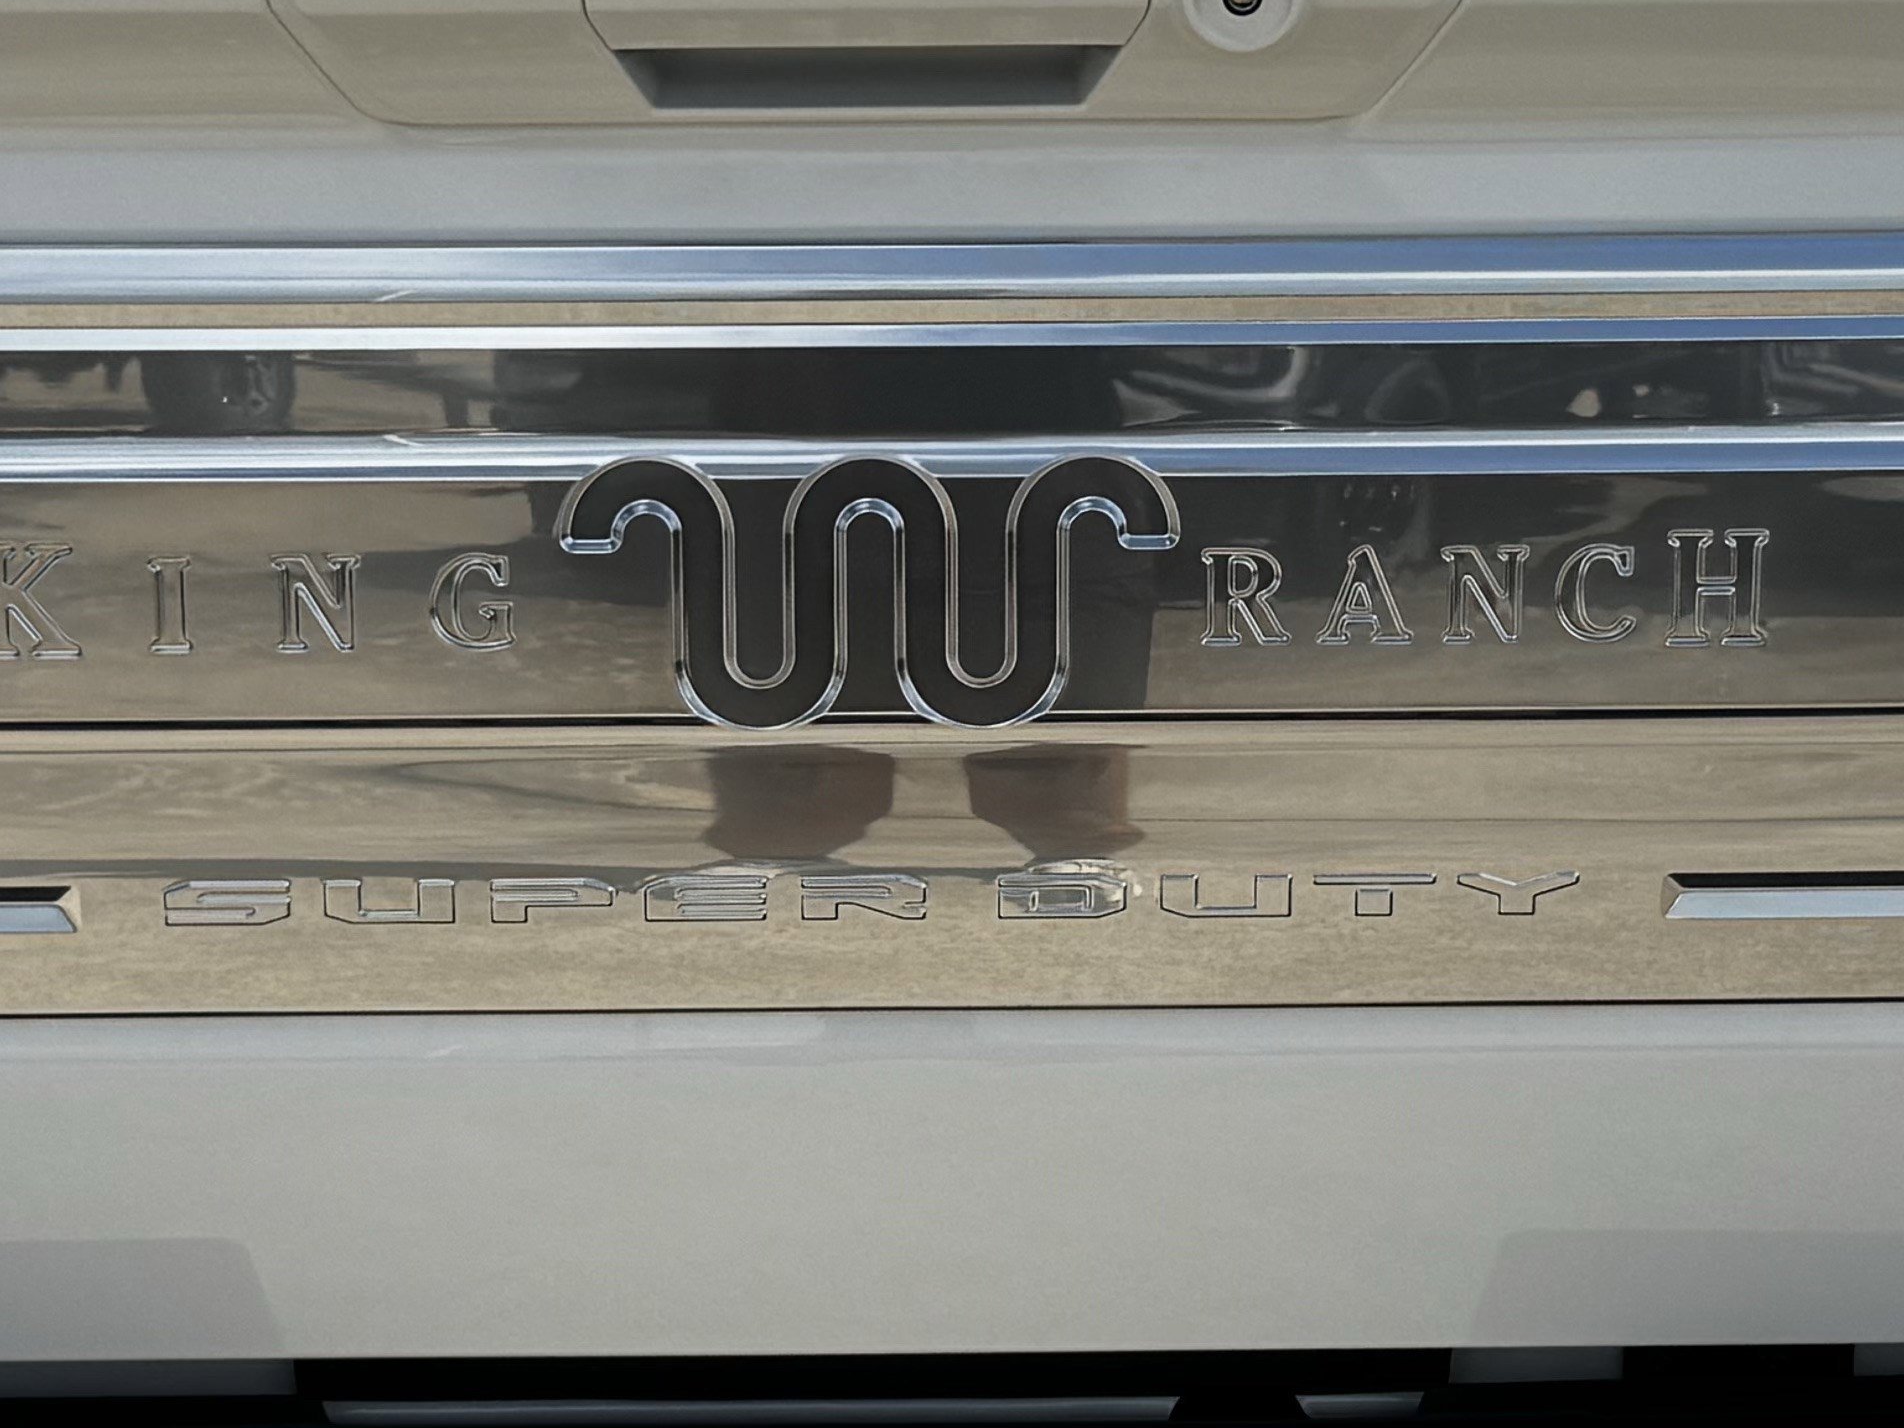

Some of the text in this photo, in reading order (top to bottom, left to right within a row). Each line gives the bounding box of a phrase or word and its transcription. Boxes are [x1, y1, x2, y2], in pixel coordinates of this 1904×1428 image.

[1198, 528, 1771, 648] RANCH
[163, 871, 1581, 926] SUPER DUTY
